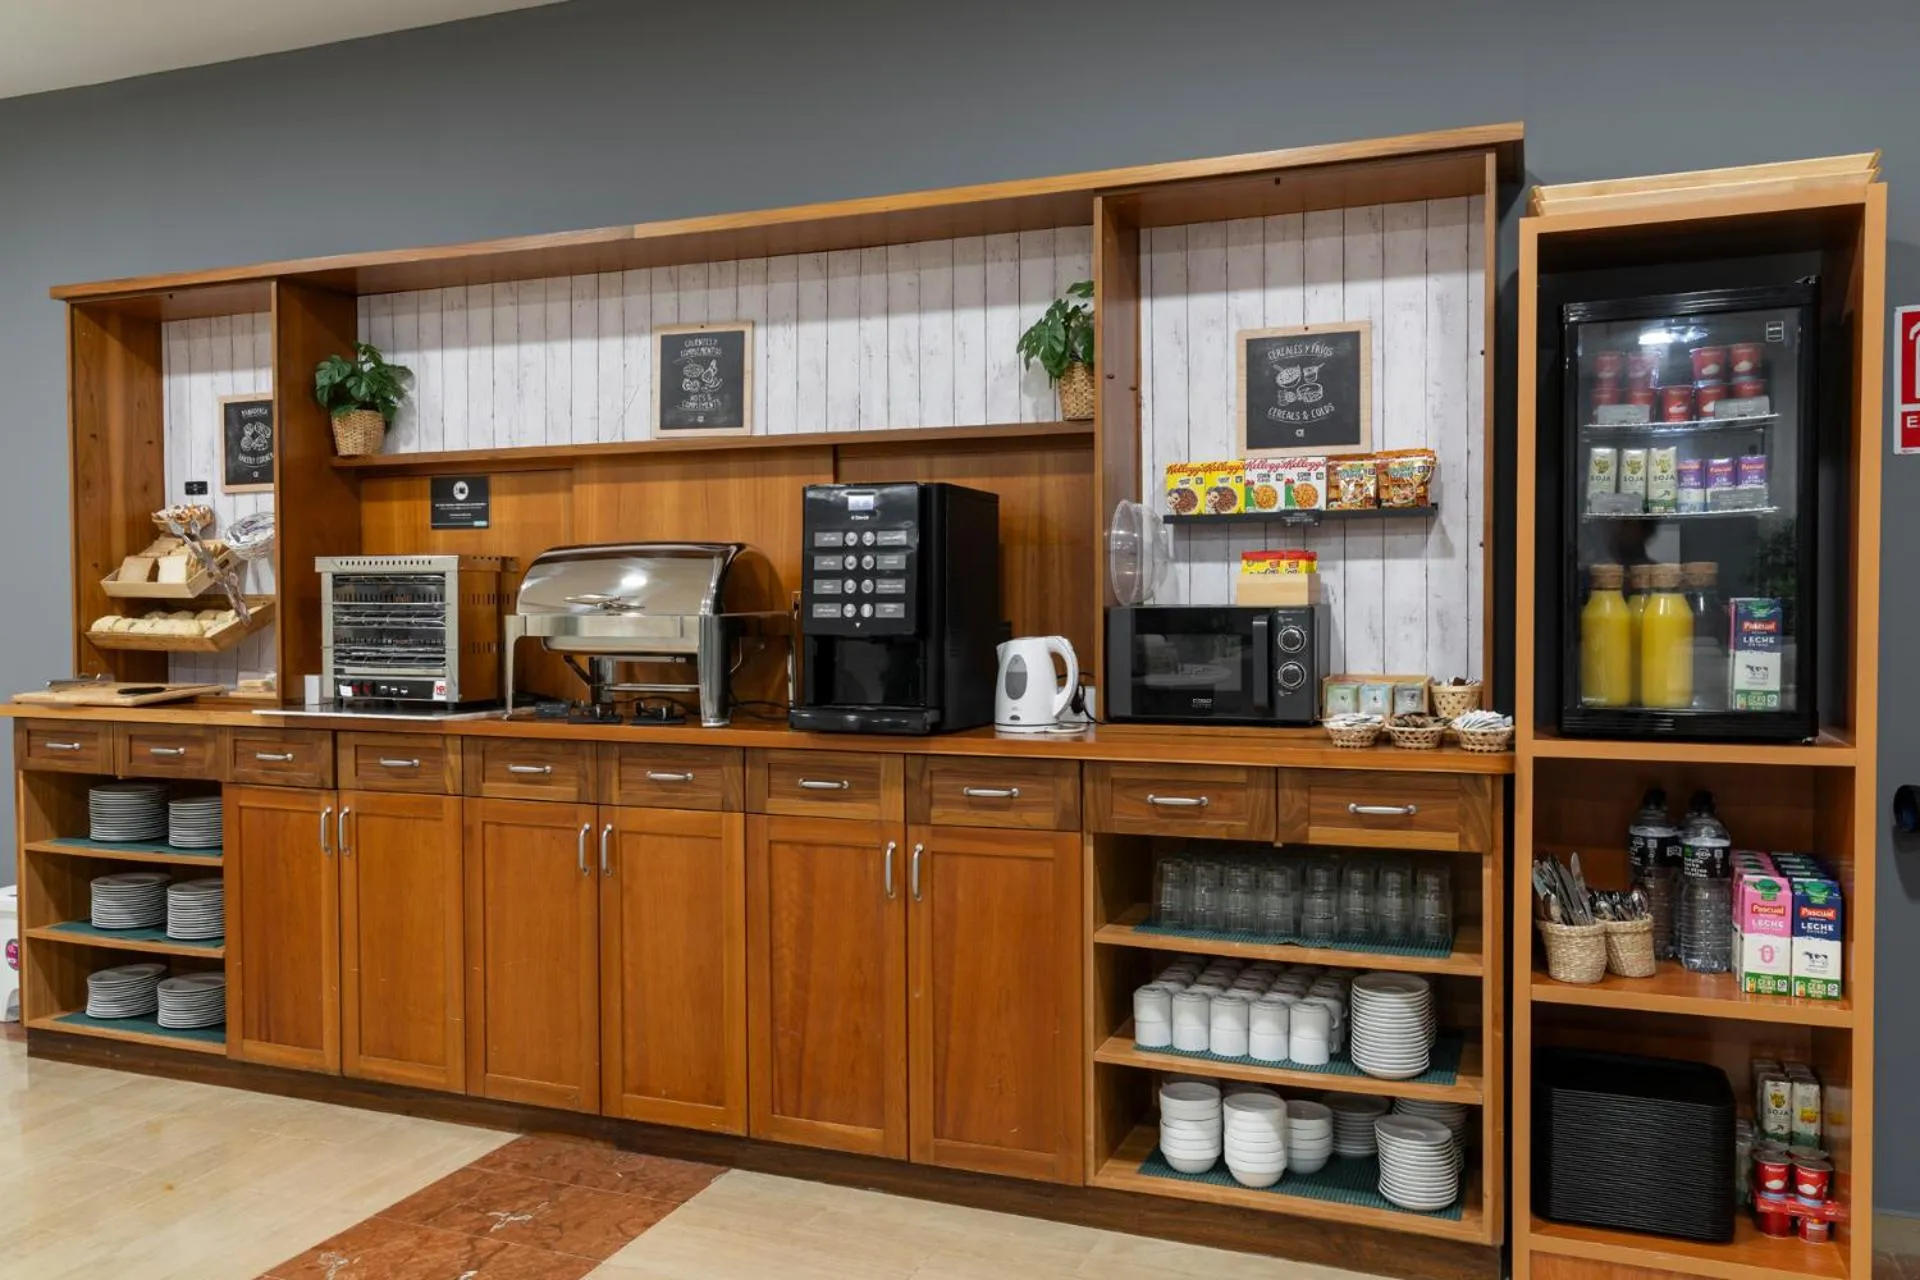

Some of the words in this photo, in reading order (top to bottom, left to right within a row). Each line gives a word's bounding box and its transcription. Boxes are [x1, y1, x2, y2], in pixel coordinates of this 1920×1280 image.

[1267, 406, 1301, 421] CEREALS
[1303, 410, 1310, 420] &
[1743, 636, 1775, 644] LECHE
[1752, 904, 1784, 915] Pascual
[1800, 907, 1835, 918] Pascual
[1801, 922, 1835, 932] LECHE
